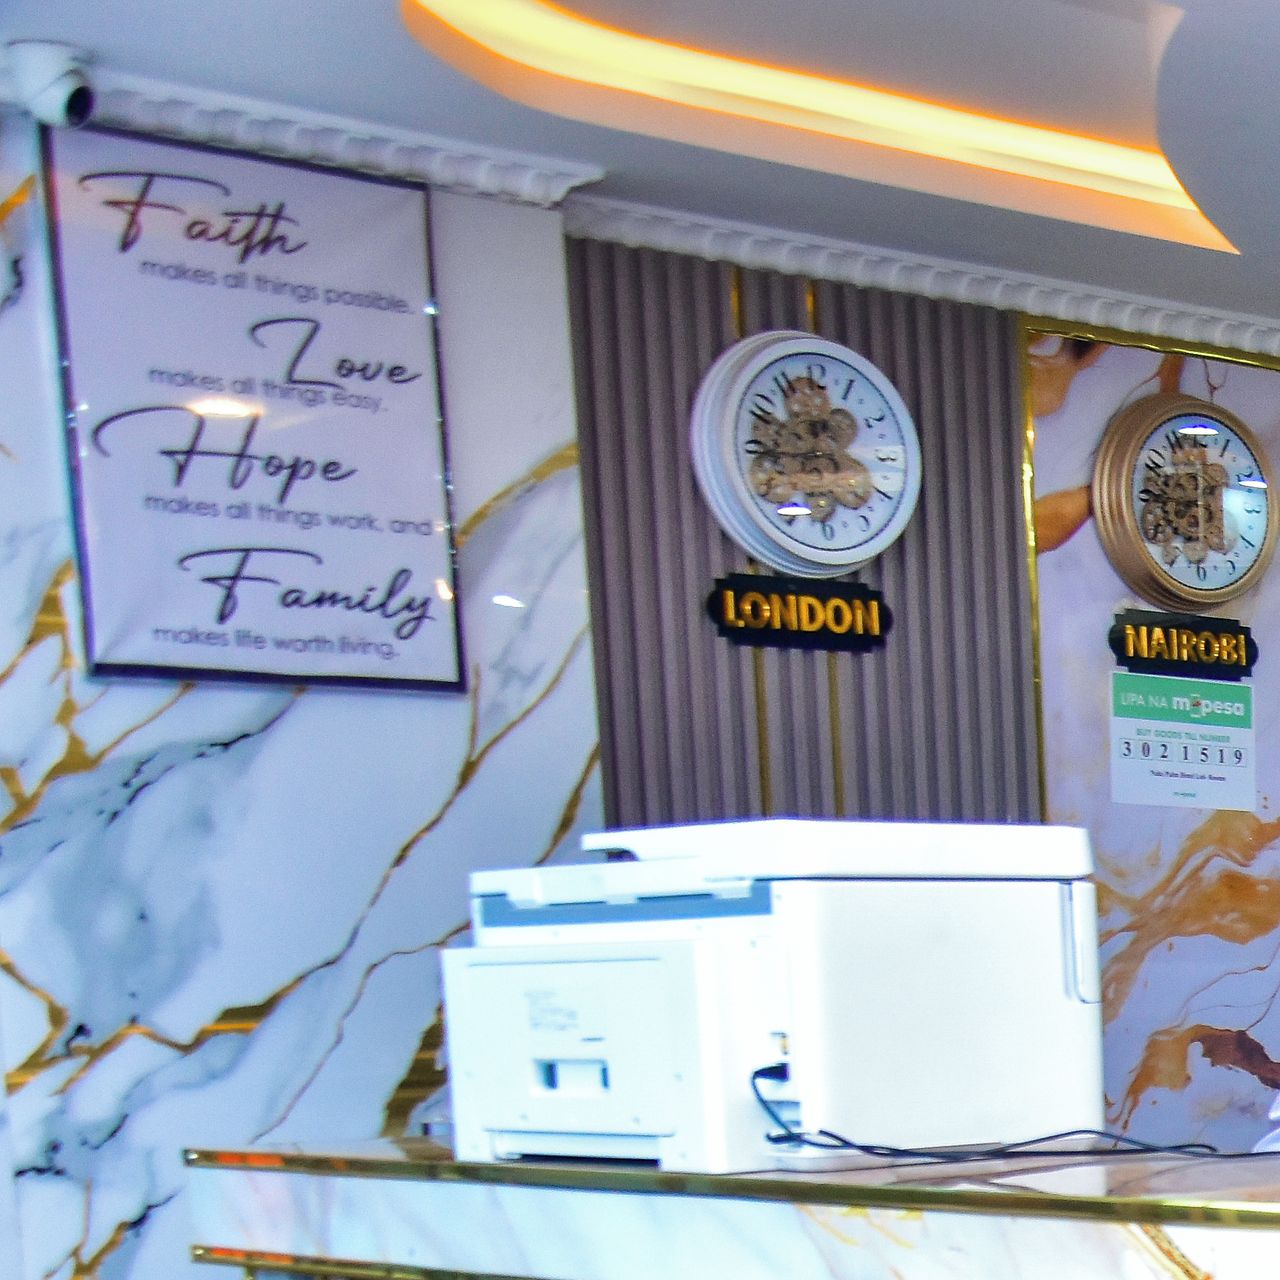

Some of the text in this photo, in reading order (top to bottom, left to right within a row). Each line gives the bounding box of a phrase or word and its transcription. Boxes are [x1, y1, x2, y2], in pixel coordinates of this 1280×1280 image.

[78, 172, 308, 264] Faith
[140, 260, 217, 286] makes
[222, 272, 248, 290] all
[255, 274, 320, 303] things
[249, 317, 422, 390] Love
[149, 369, 226, 393] makes
[231, 377, 258, 395] all
[261, 380, 326, 408] things
[93, 406, 357, 504] Hope
[145, 496, 221, 517] makes
[226, 503, 250, 519] all
[257, 504, 322, 530] things
[390, 518, 434, 536] and
[178, 547, 436, 640] Family
[723, 589, 881, 636] LONDON
[153, 628, 229, 647] makes
[234, 628, 268, 649] life
[272, 635, 336, 653] worth
[1124, 624, 1247, 666] NAIROBI
[1122, 741, 1132, 757] 3
[1159, 743, 1169, 759] 2
[1182, 745, 1189, 761] 1
[1200, 747, 1209, 763] 5
[1219, 748, 1226, 764] 1
[1233, 749, 1243, 765] 9
